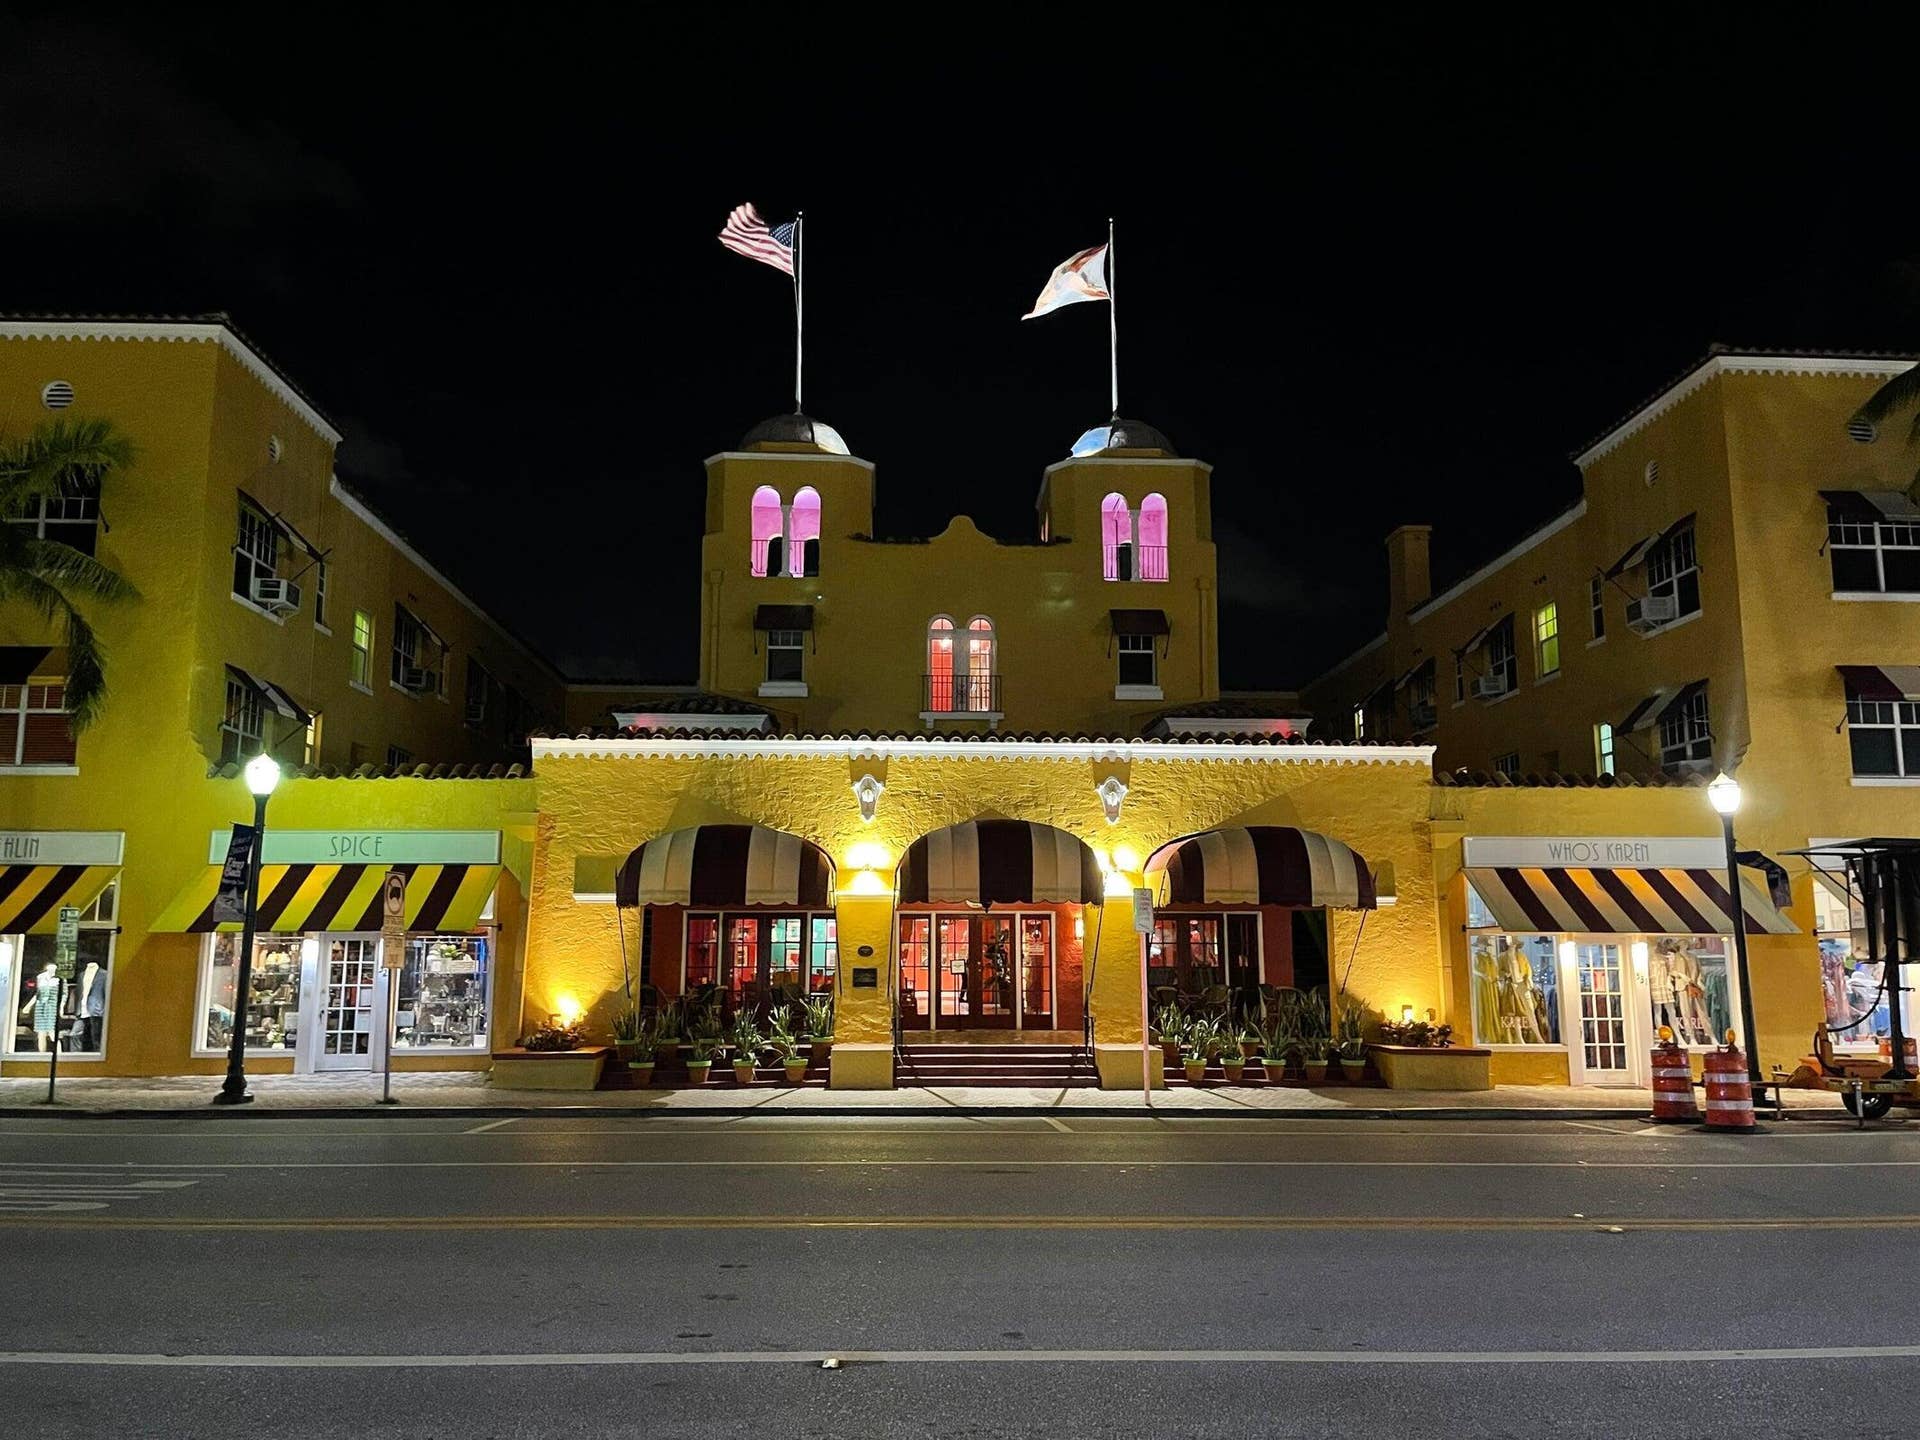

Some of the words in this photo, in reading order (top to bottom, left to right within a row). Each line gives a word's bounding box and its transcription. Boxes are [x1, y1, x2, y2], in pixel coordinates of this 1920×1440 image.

[0, 837, 40, 858] HLIN
[329, 835, 383, 857] SPICE
[1548, 842, 1600, 861] WHO'S
[1606, 843, 1650, 861] KAREN
